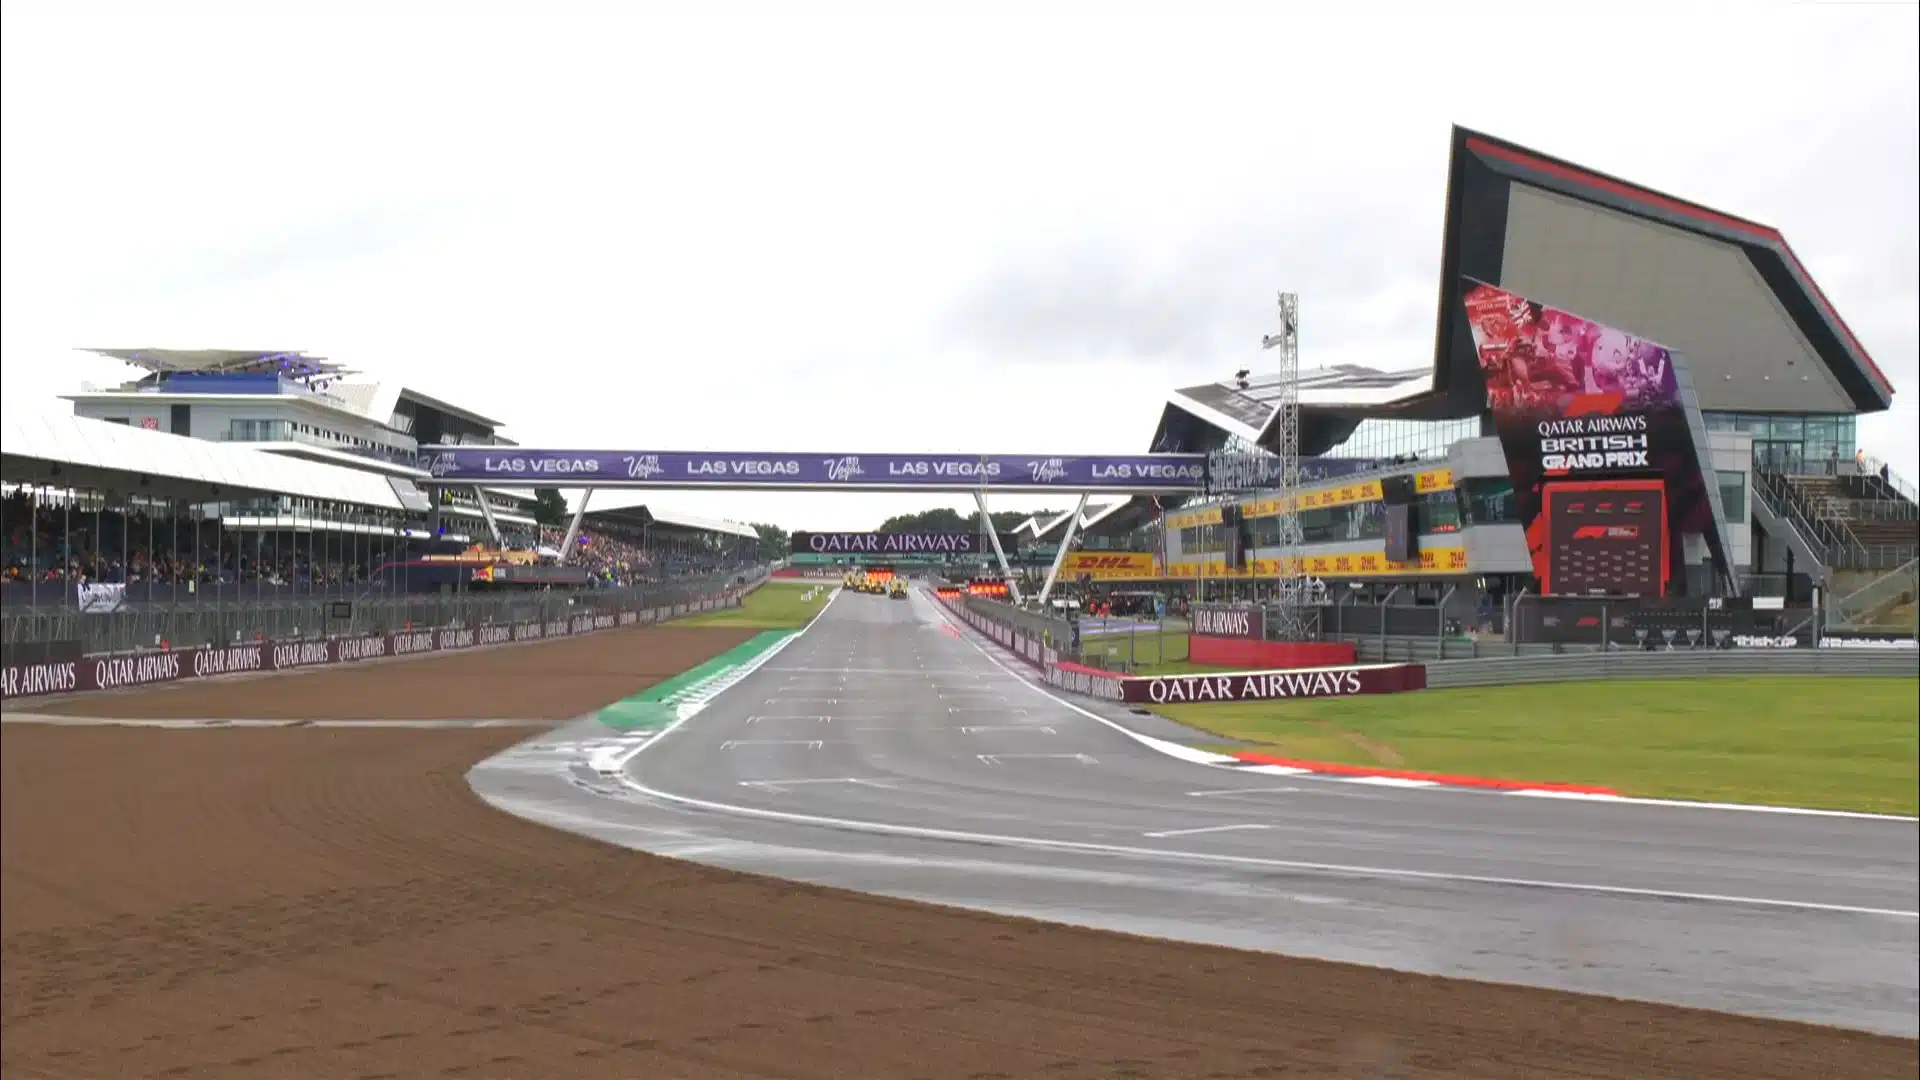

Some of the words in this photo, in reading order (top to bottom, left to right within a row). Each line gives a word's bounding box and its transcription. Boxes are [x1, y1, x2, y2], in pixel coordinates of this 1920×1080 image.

[1539, 418, 1585, 437] QATAR
[1588, 415, 1647, 433] AIRWAYS
[1541, 434, 1648, 452] BRITISH
[485, 458, 525, 472] LAS
[530, 459, 599, 472] VEGAS
[687, 460, 727, 474] LAS
[731, 461, 800, 474] VEGAS
[889, 461, 929, 475] LAS
[932, 462, 1001, 476] VEGAS
[1542, 453, 1604, 470] GRAND
[1605, 450, 1649, 468] PRIX
[1092, 463, 1132, 478] LAS
[1135, 465, 1204, 479] VEGAS
[810, 534, 878, 552] QATAR
[884, 534, 971, 551] AIRWAYS
[1077, 556, 1135, 569] DHL
[1212, 611, 1249, 635] AIRWAYS
[195, 650, 225, 676] QATAR
[226, 647, 261, 671] AIRWAYS
[274, 644, 299, 669] QATAR
[300, 642, 329, 664] AIRWAYS
[339, 641, 360, 664] QATAR
[22, 662, 76, 693] AIRWAYS
[96, 659, 134, 689] QATAR
[136, 653, 179, 681] AIRWAYS
[1149, 678, 1233, 704] QATAR
[1241, 671, 1361, 698] AIRWAYS
